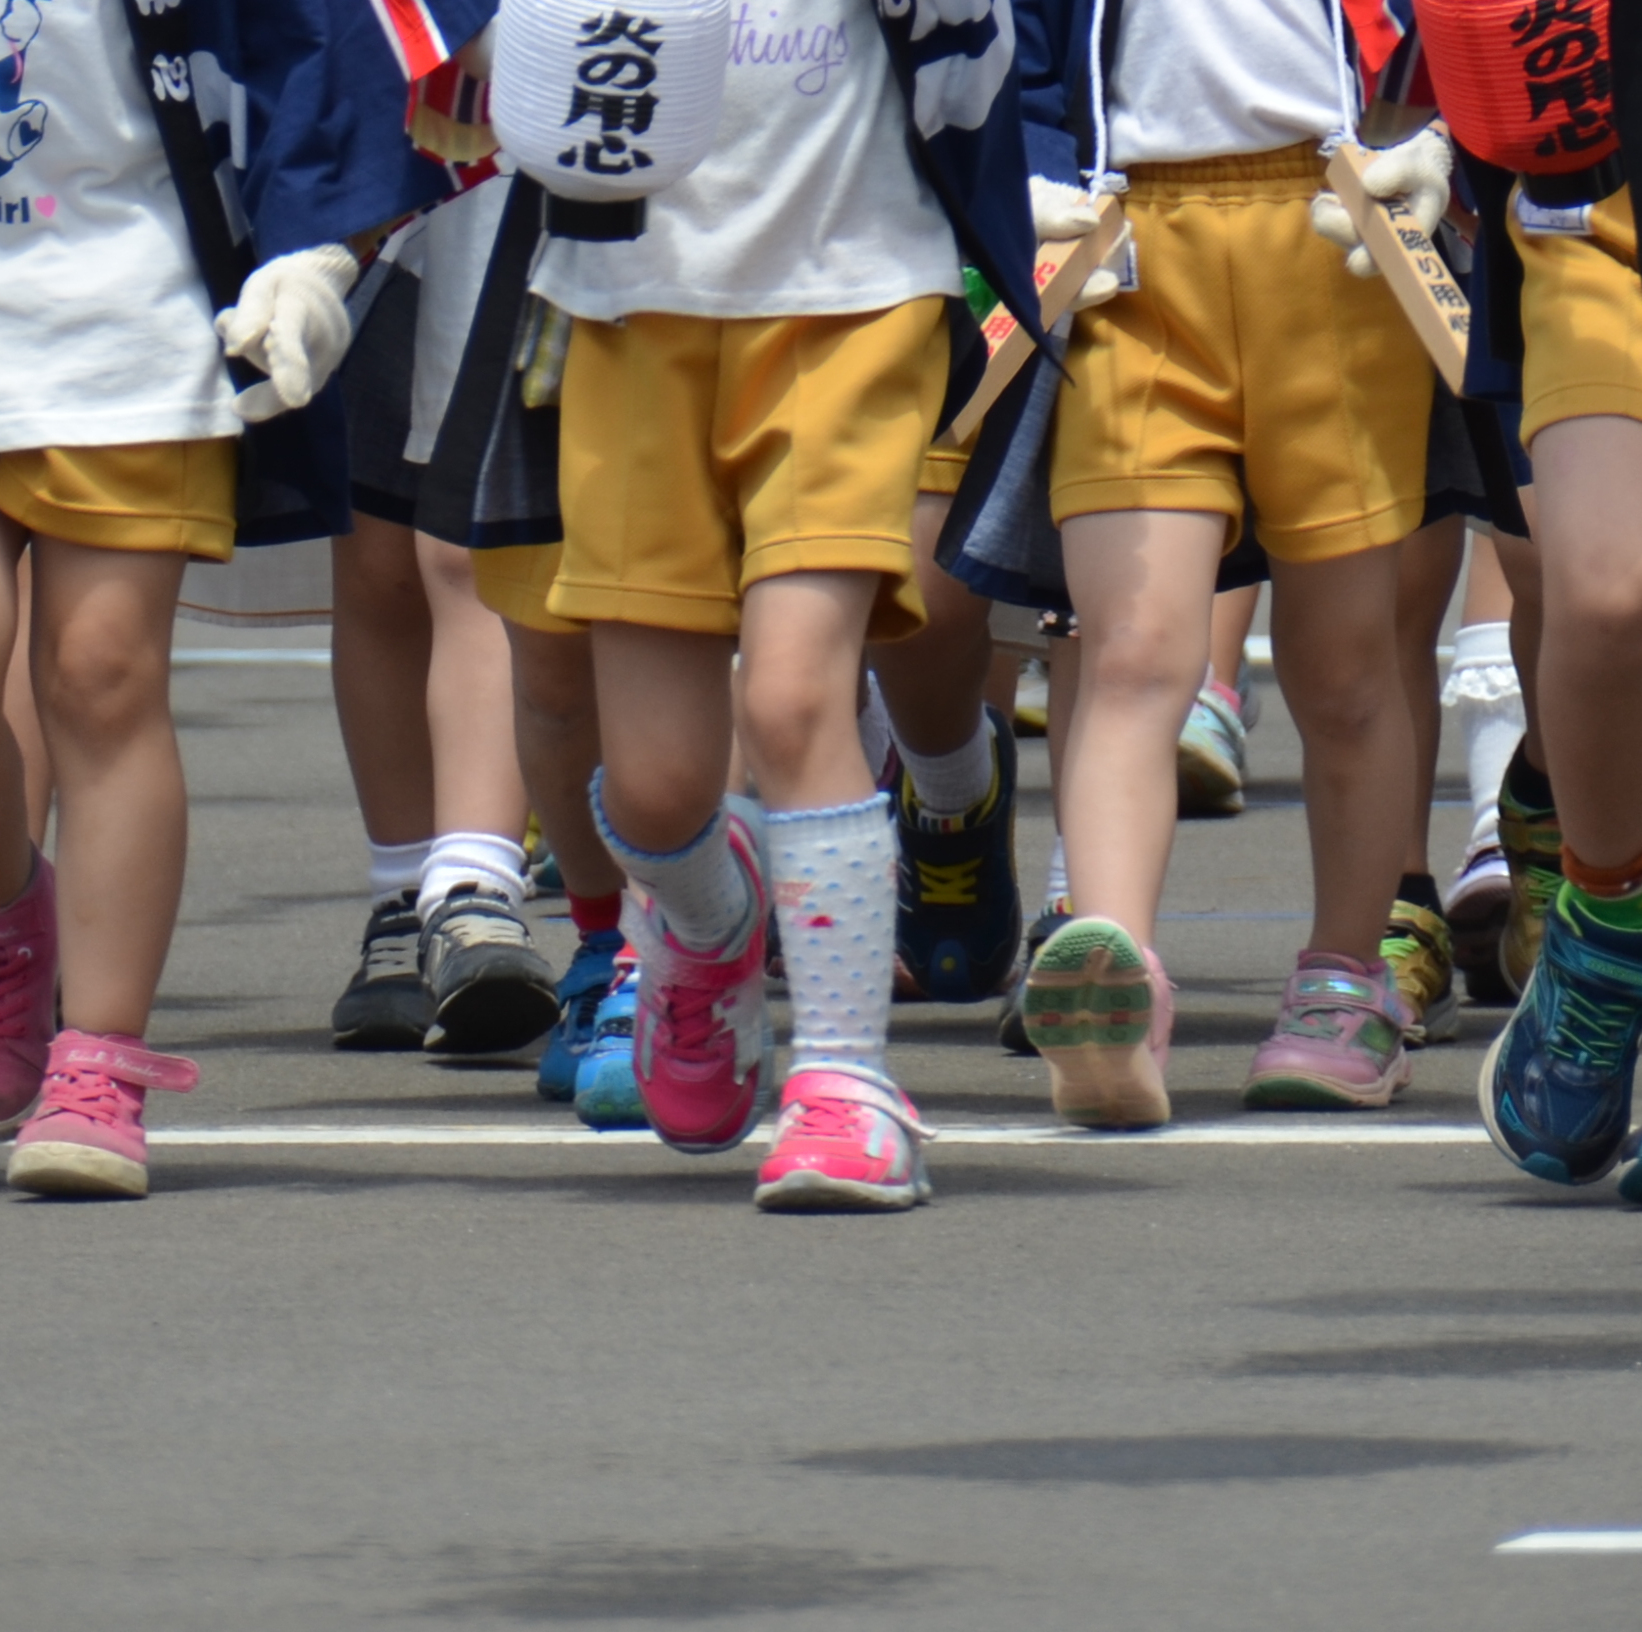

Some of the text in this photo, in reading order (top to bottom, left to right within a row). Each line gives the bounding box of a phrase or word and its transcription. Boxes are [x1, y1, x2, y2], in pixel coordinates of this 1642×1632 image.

[558, 8, 666, 175] 火の用心
[728, 2, 850, 97] things
